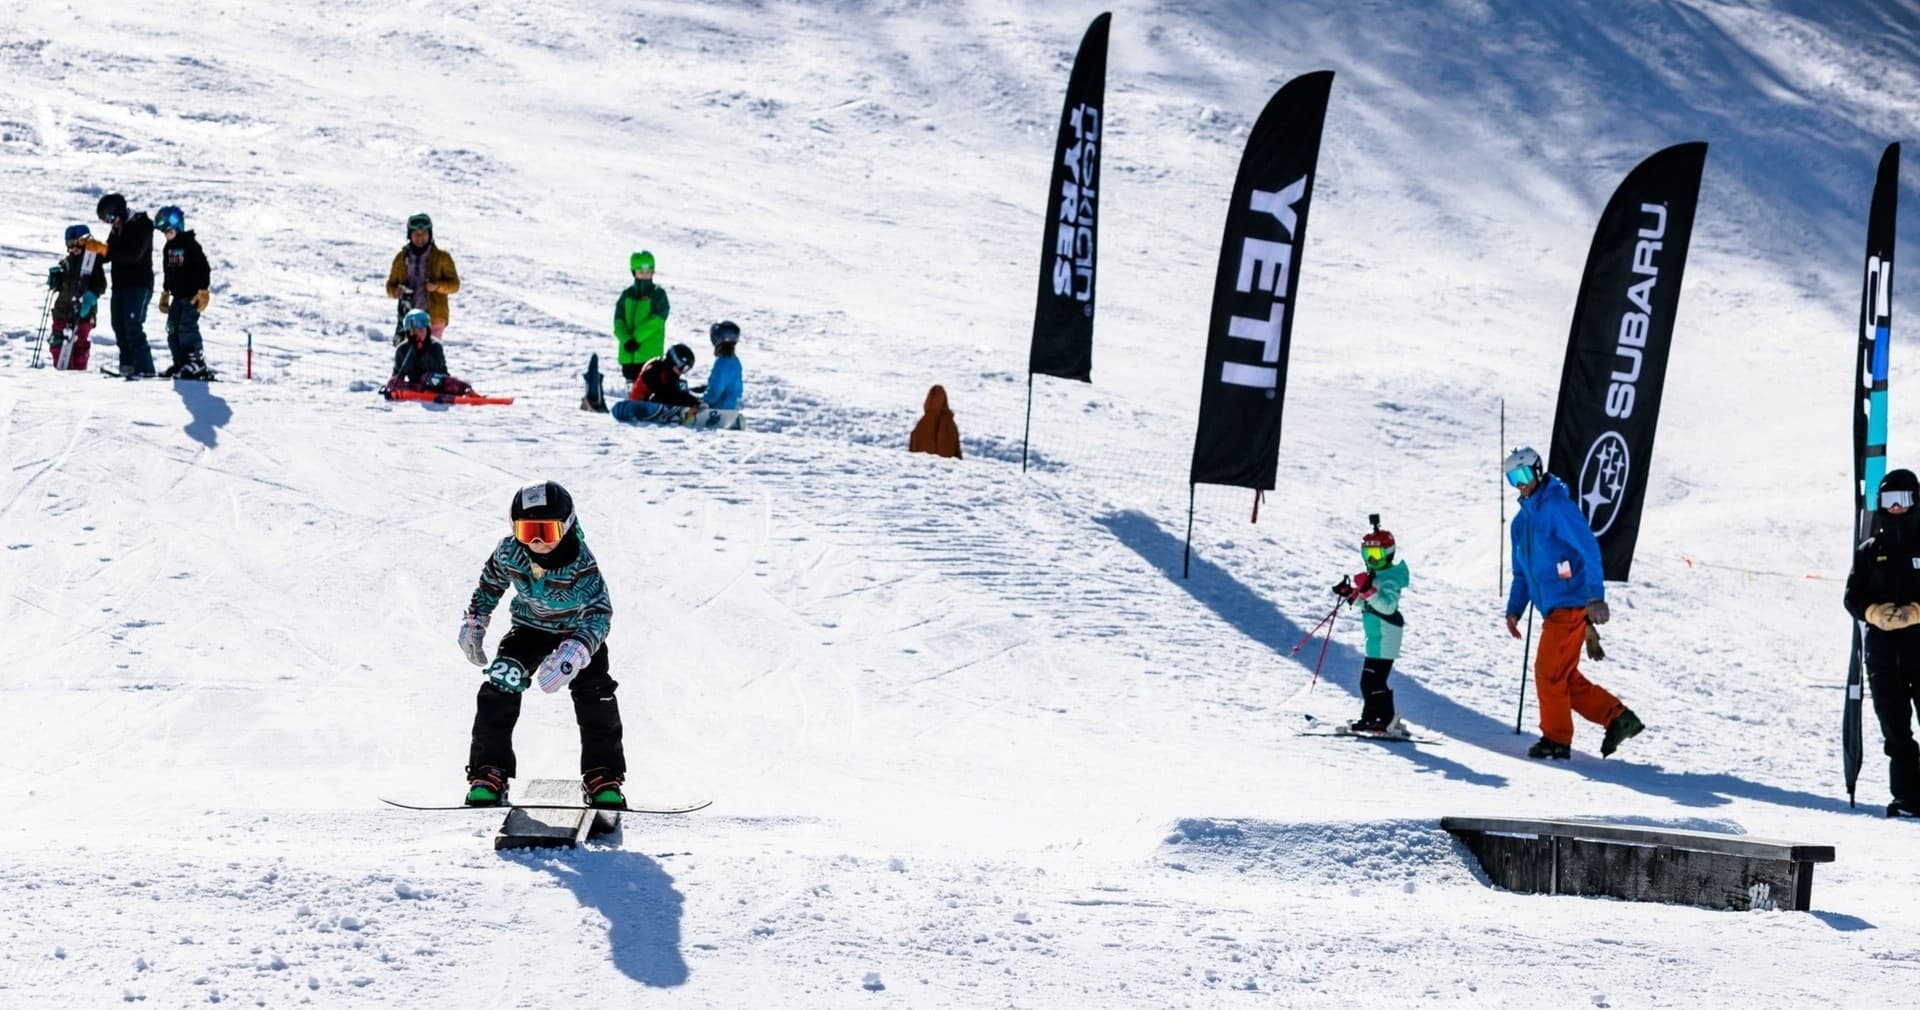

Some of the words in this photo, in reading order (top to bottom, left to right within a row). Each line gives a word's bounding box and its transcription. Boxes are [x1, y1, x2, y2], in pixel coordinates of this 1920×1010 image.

[1053, 103, 1086, 296] TYRES
[1221, 174, 1307, 388] YETI
[1605, 203, 1668, 420] SUBARU
[491, 661, 522, 687] 28
